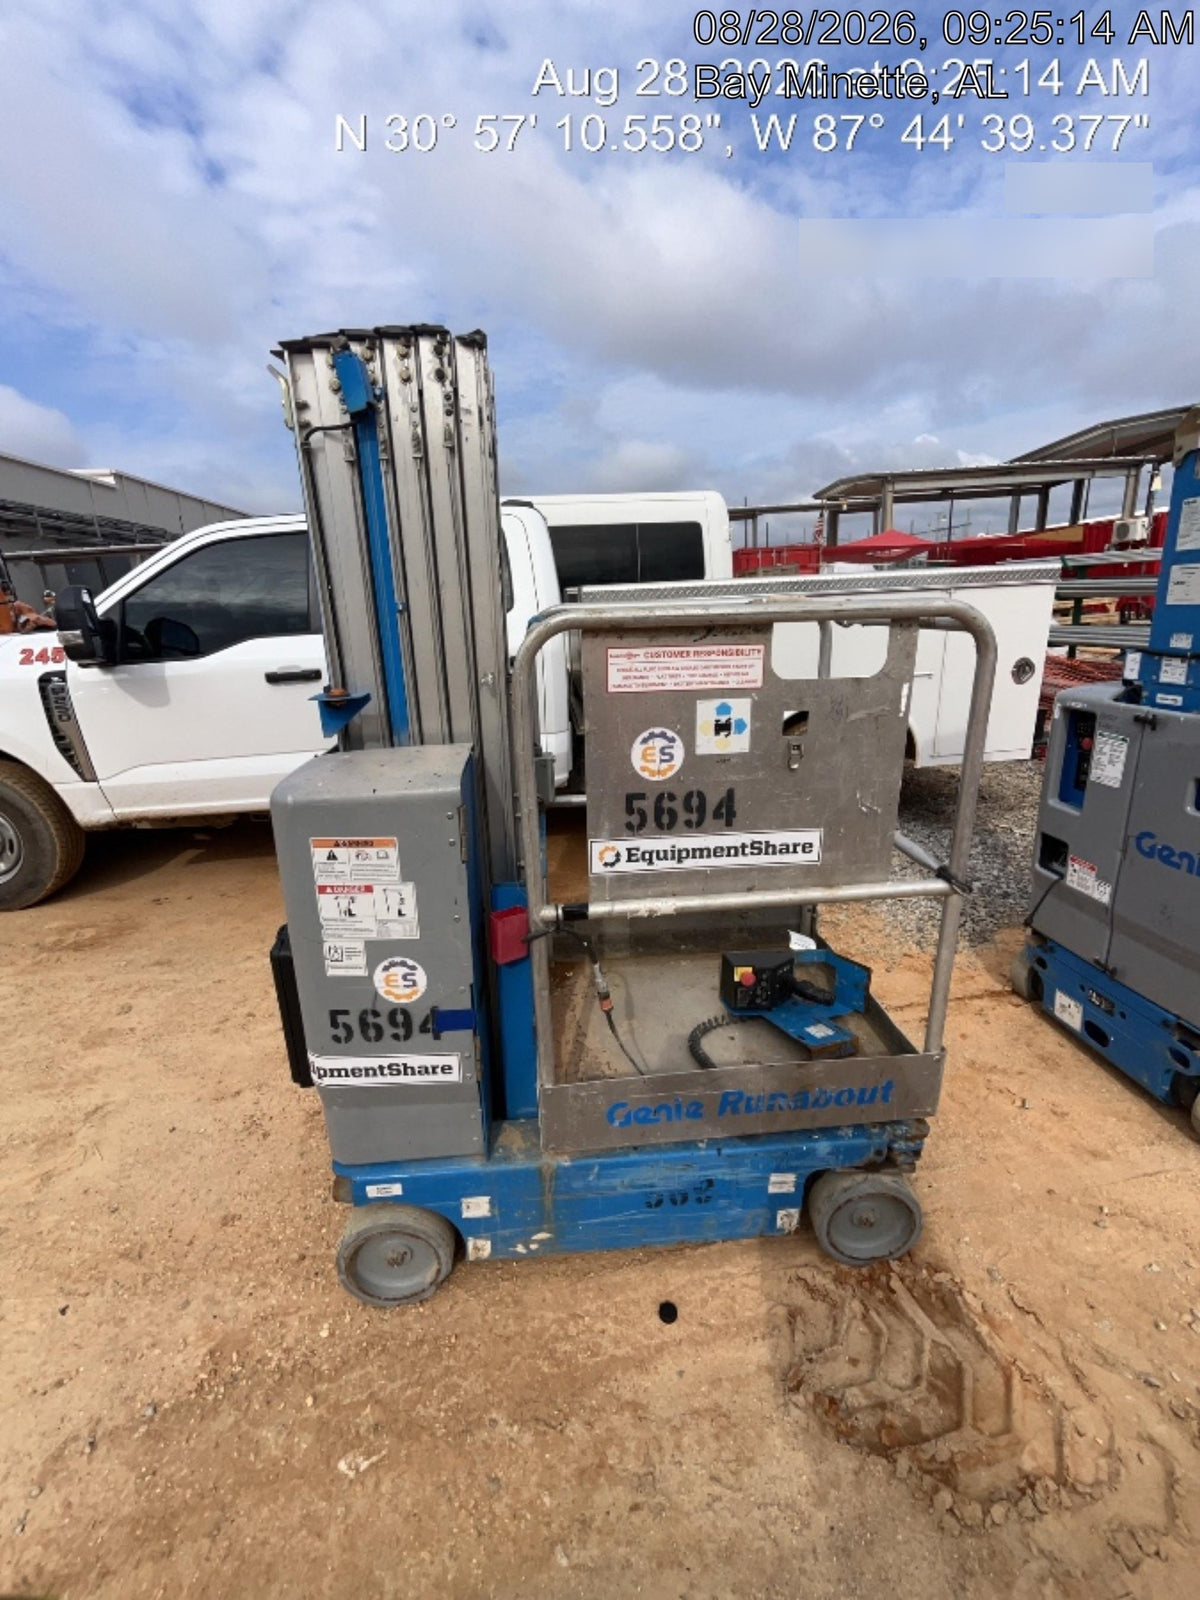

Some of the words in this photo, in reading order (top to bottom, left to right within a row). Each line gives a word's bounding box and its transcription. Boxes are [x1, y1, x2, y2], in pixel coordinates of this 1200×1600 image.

[19, 646, 65, 665] 245
[624, 787, 737, 833] 5694
[625, 840, 813, 866] EquipmentShare
[606, 1098, 704, 1128] Genie
[718, 1080, 894, 1117] Runabout
